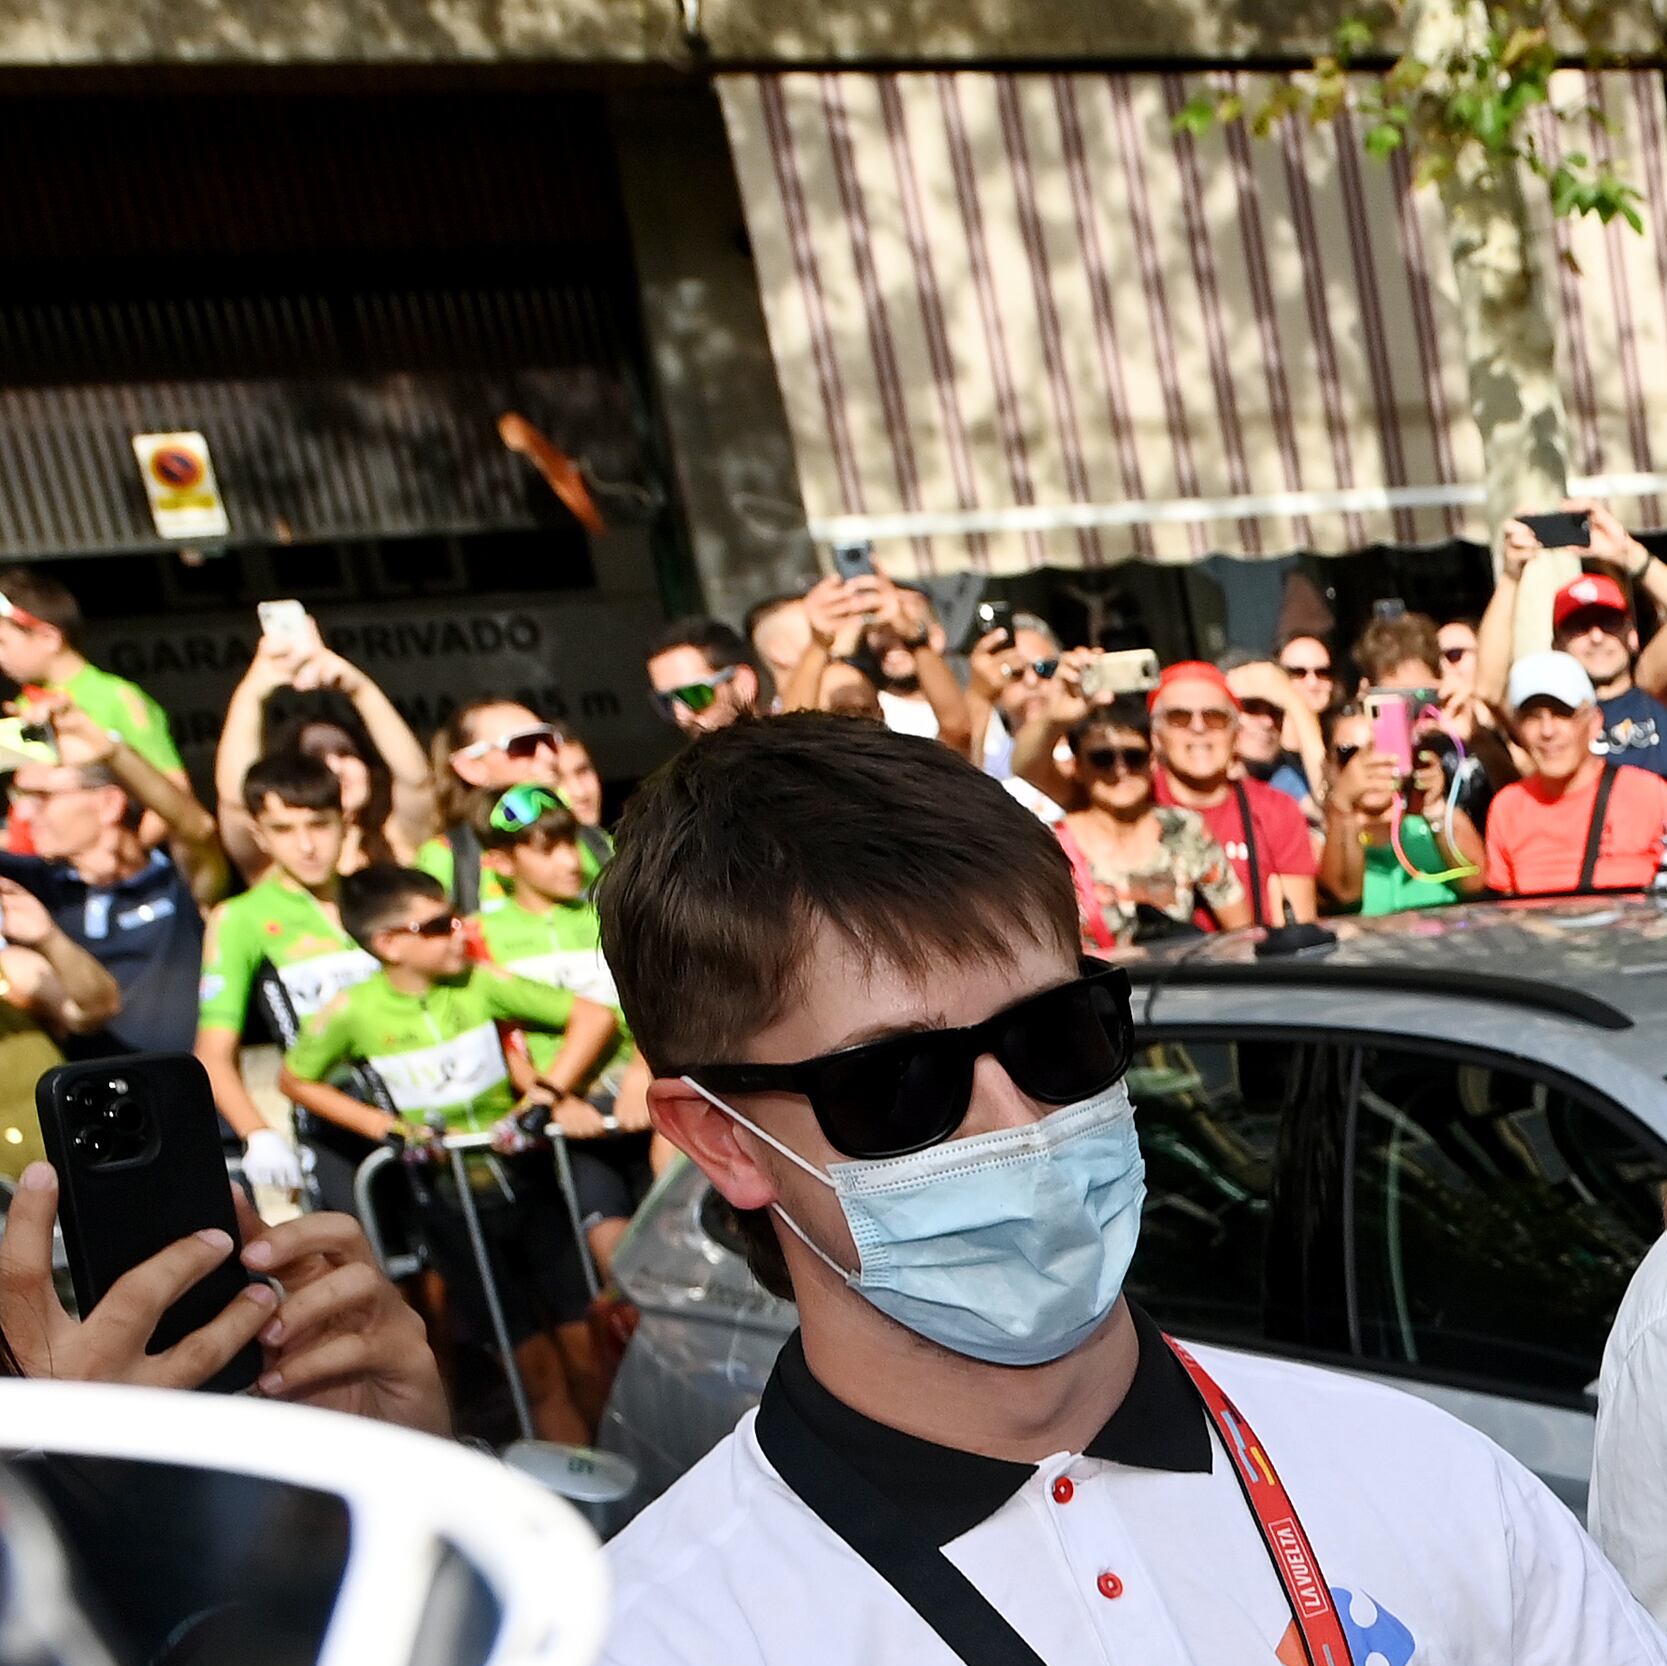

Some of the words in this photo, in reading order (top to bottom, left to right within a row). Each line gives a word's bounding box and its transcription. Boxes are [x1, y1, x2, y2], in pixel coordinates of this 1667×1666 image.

[330, 615, 541, 660] PRIVADO
[1277, 1527, 1317, 1588] VUELTA
[1301, 1583, 1322, 1608] LA
